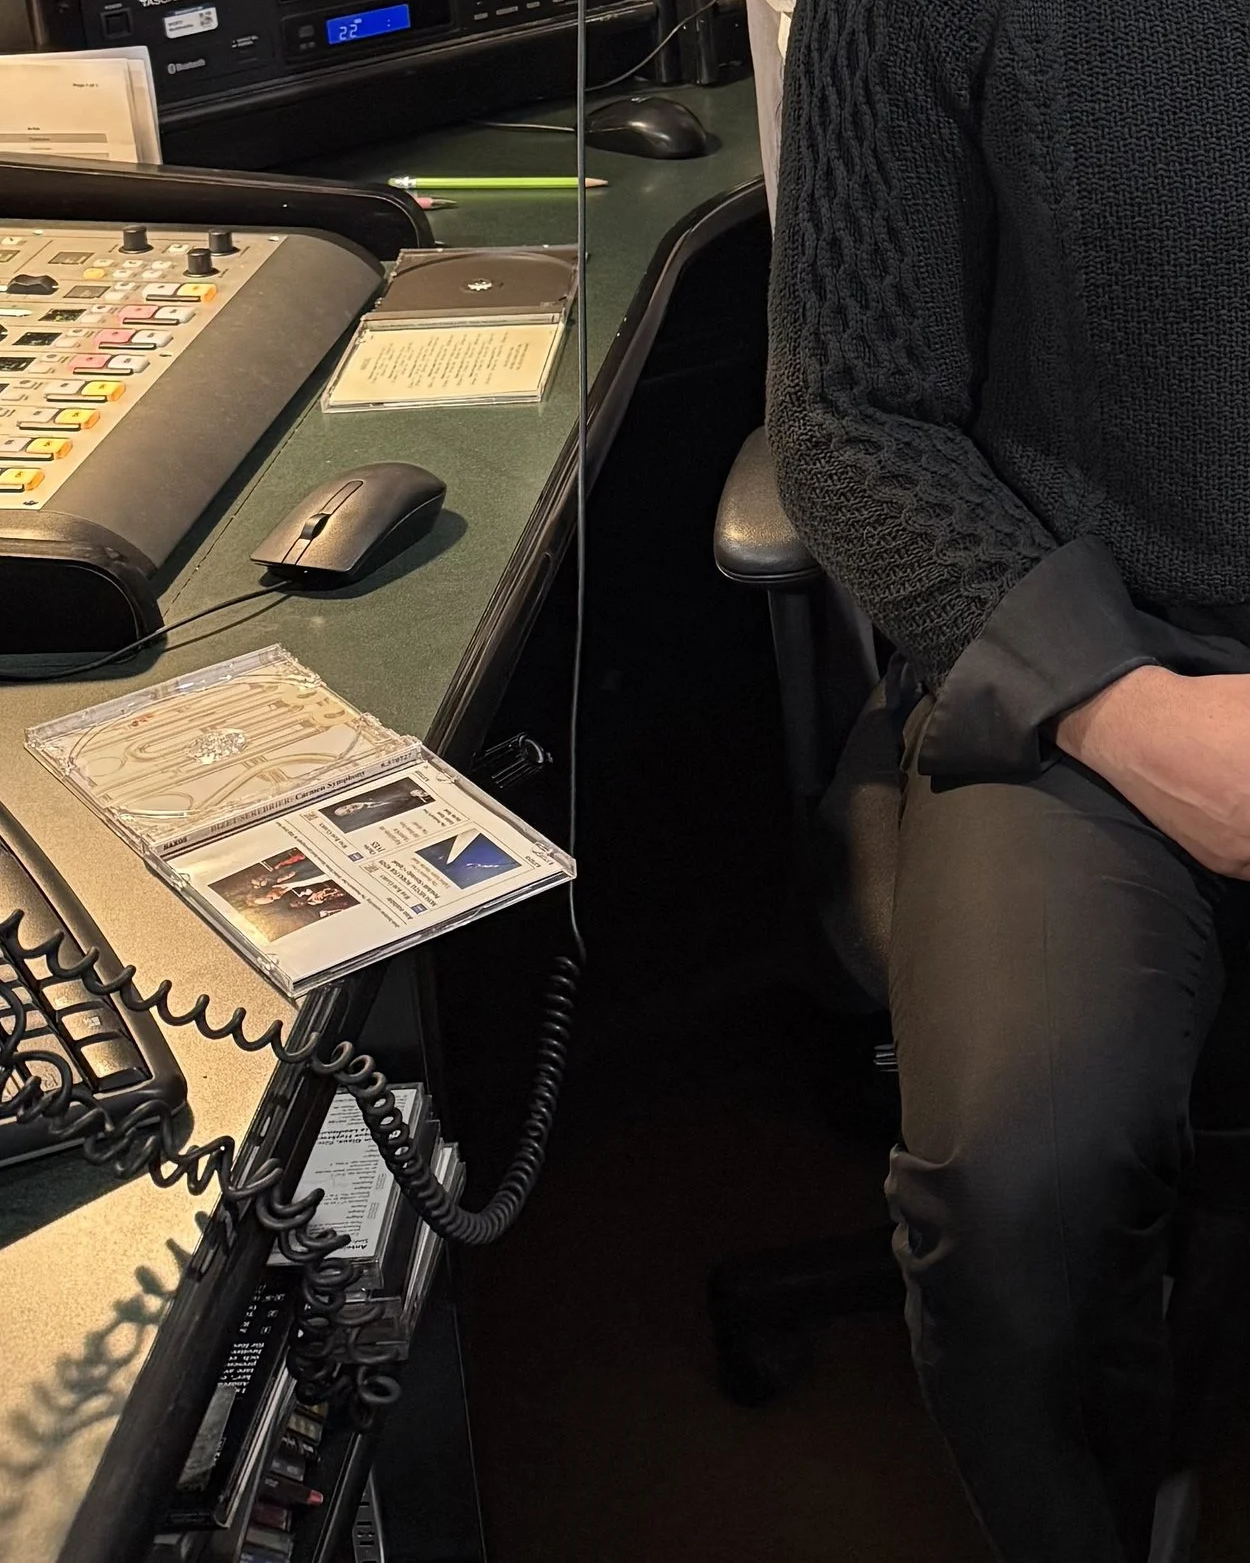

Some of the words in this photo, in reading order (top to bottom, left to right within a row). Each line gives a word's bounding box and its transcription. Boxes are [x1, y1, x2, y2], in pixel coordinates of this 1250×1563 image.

[338, 23, 358, 41] 22
[294, 783, 326, 801] Carmen
[326, 770, 366, 791] Symphony
